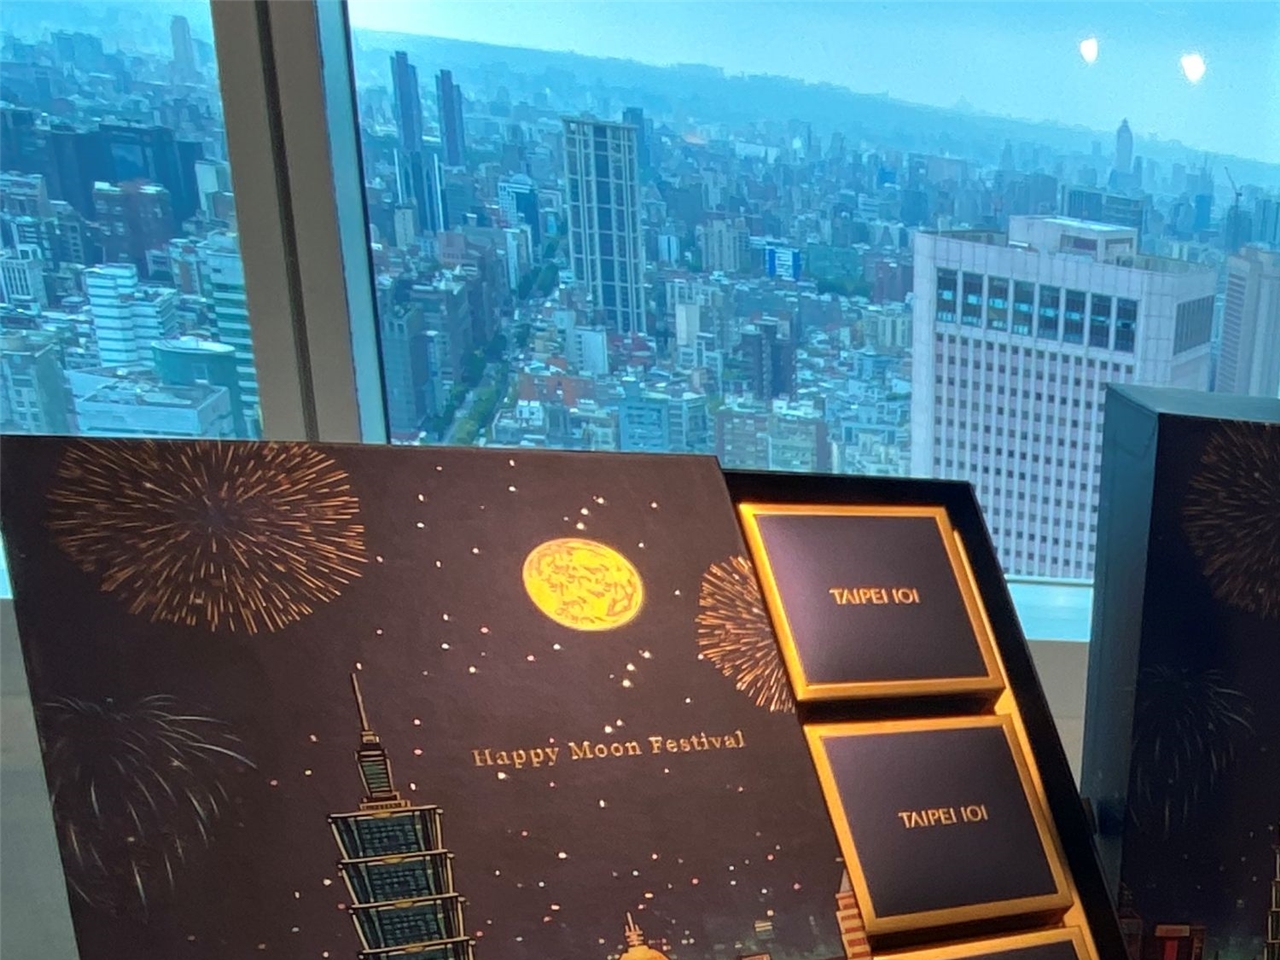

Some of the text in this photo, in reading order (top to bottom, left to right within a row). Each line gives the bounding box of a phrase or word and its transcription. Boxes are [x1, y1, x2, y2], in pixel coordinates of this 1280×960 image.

[828, 587, 888, 605] TAIPEI
[473, 730, 745, 769] Happy Moon Festival
[897, 807, 956, 828] TAIPEI
